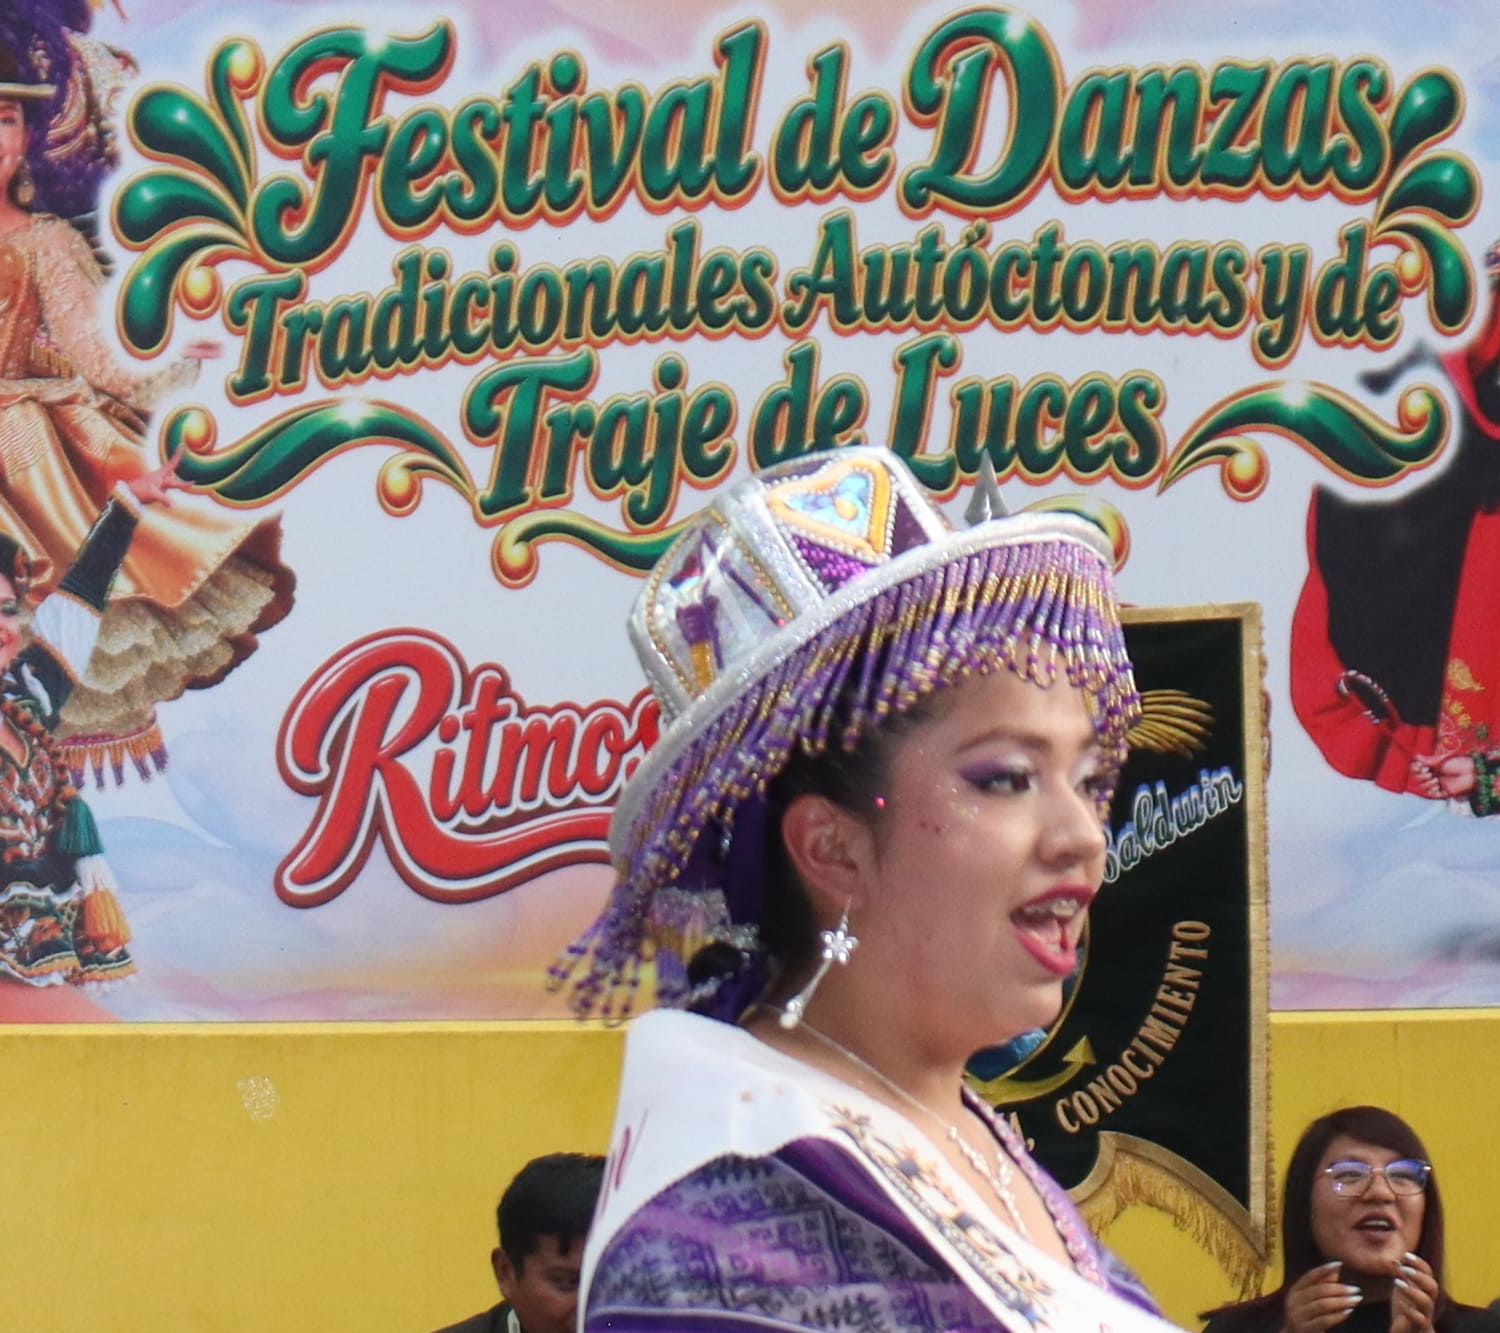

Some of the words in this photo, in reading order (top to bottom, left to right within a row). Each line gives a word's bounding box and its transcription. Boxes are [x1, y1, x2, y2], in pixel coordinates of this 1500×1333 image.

[248, 16, 767, 270] Festival
[770, 38, 895, 204] de
[898, 5, 1394, 218] Danzas
[224, 216, 778, 402] Tradicionales
[780, 207, 1252, 337] Autóctonas
[1253, 242, 1309, 369] y
[1313, 216, 1401, 350] de
[460, 345, 738, 531] Traje
[747, 341, 871, 472] de
[889, 330, 1168, 502] Luces
[1055, 920, 1212, 1134] CONOCIMIENTO
